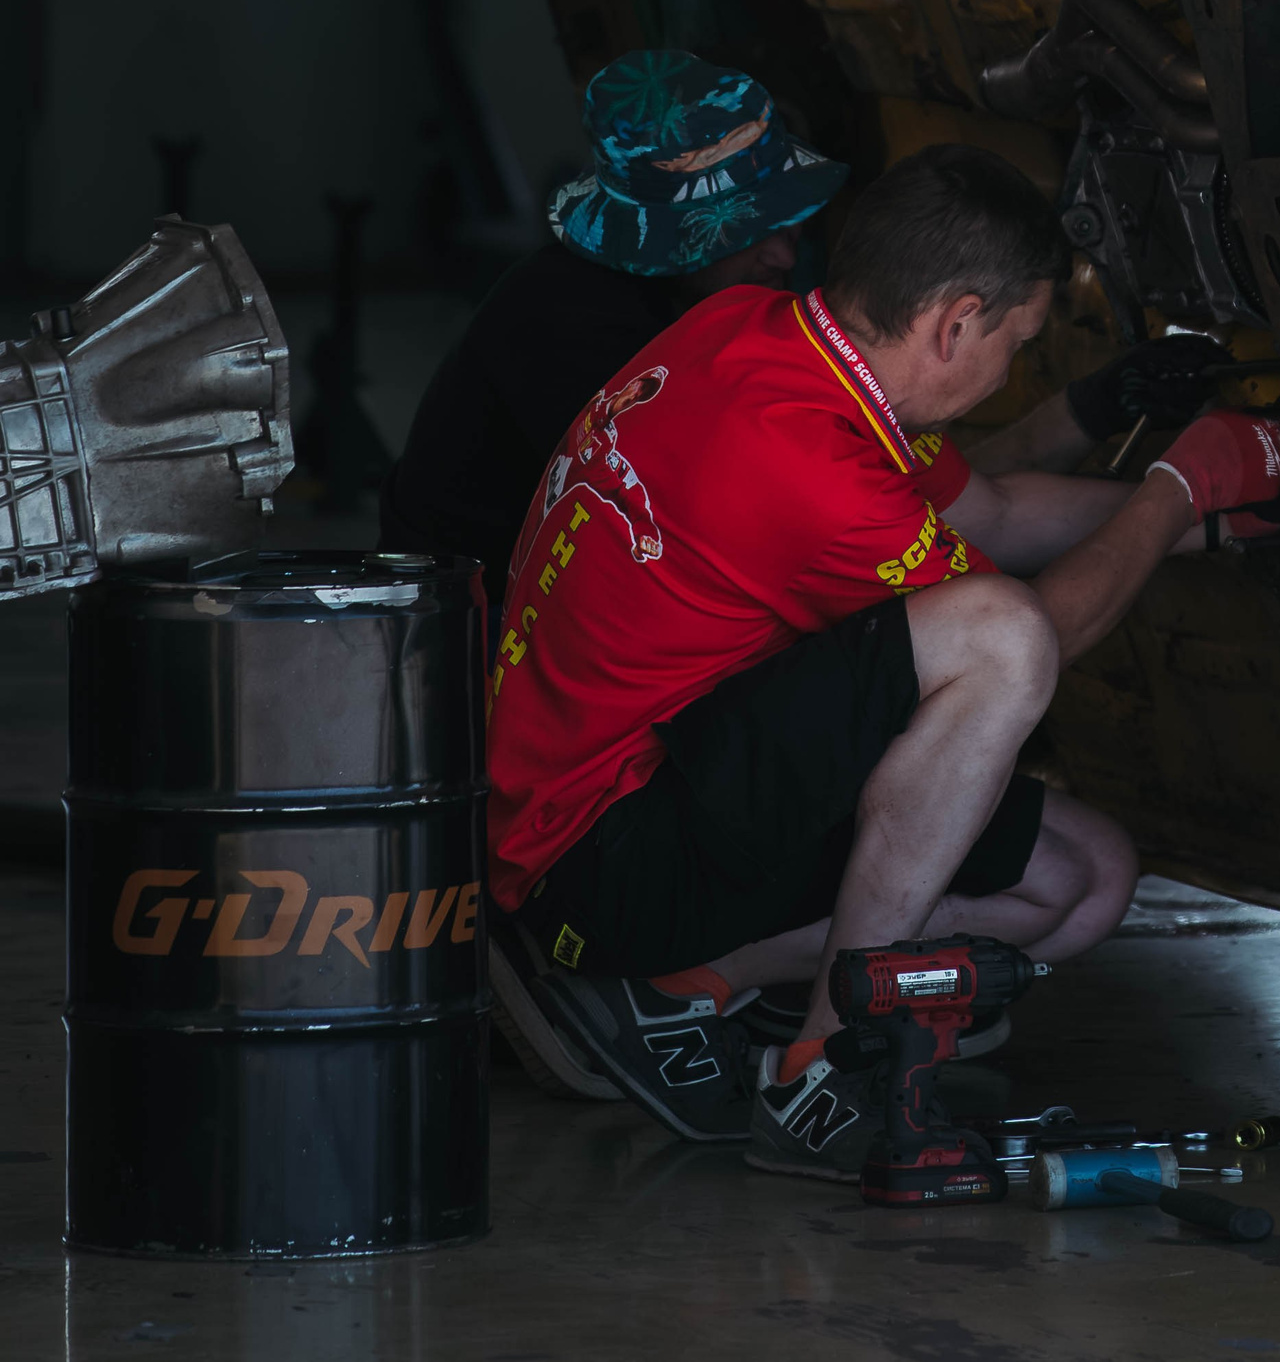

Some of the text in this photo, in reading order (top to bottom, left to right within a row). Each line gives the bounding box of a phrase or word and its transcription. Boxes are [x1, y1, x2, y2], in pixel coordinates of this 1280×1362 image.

[814, 308, 832, 331] THE
[826, 326, 859, 363] CHAMP
[853, 362, 886, 406] SCHUMI
[883, 403, 898, 426] THE
[1252, 424, 1279, 478] Milwaukee
[538, 501, 591, 596] THE
[643, 1026, 721, 1087] N
[787, 1088, 861, 1153] N
